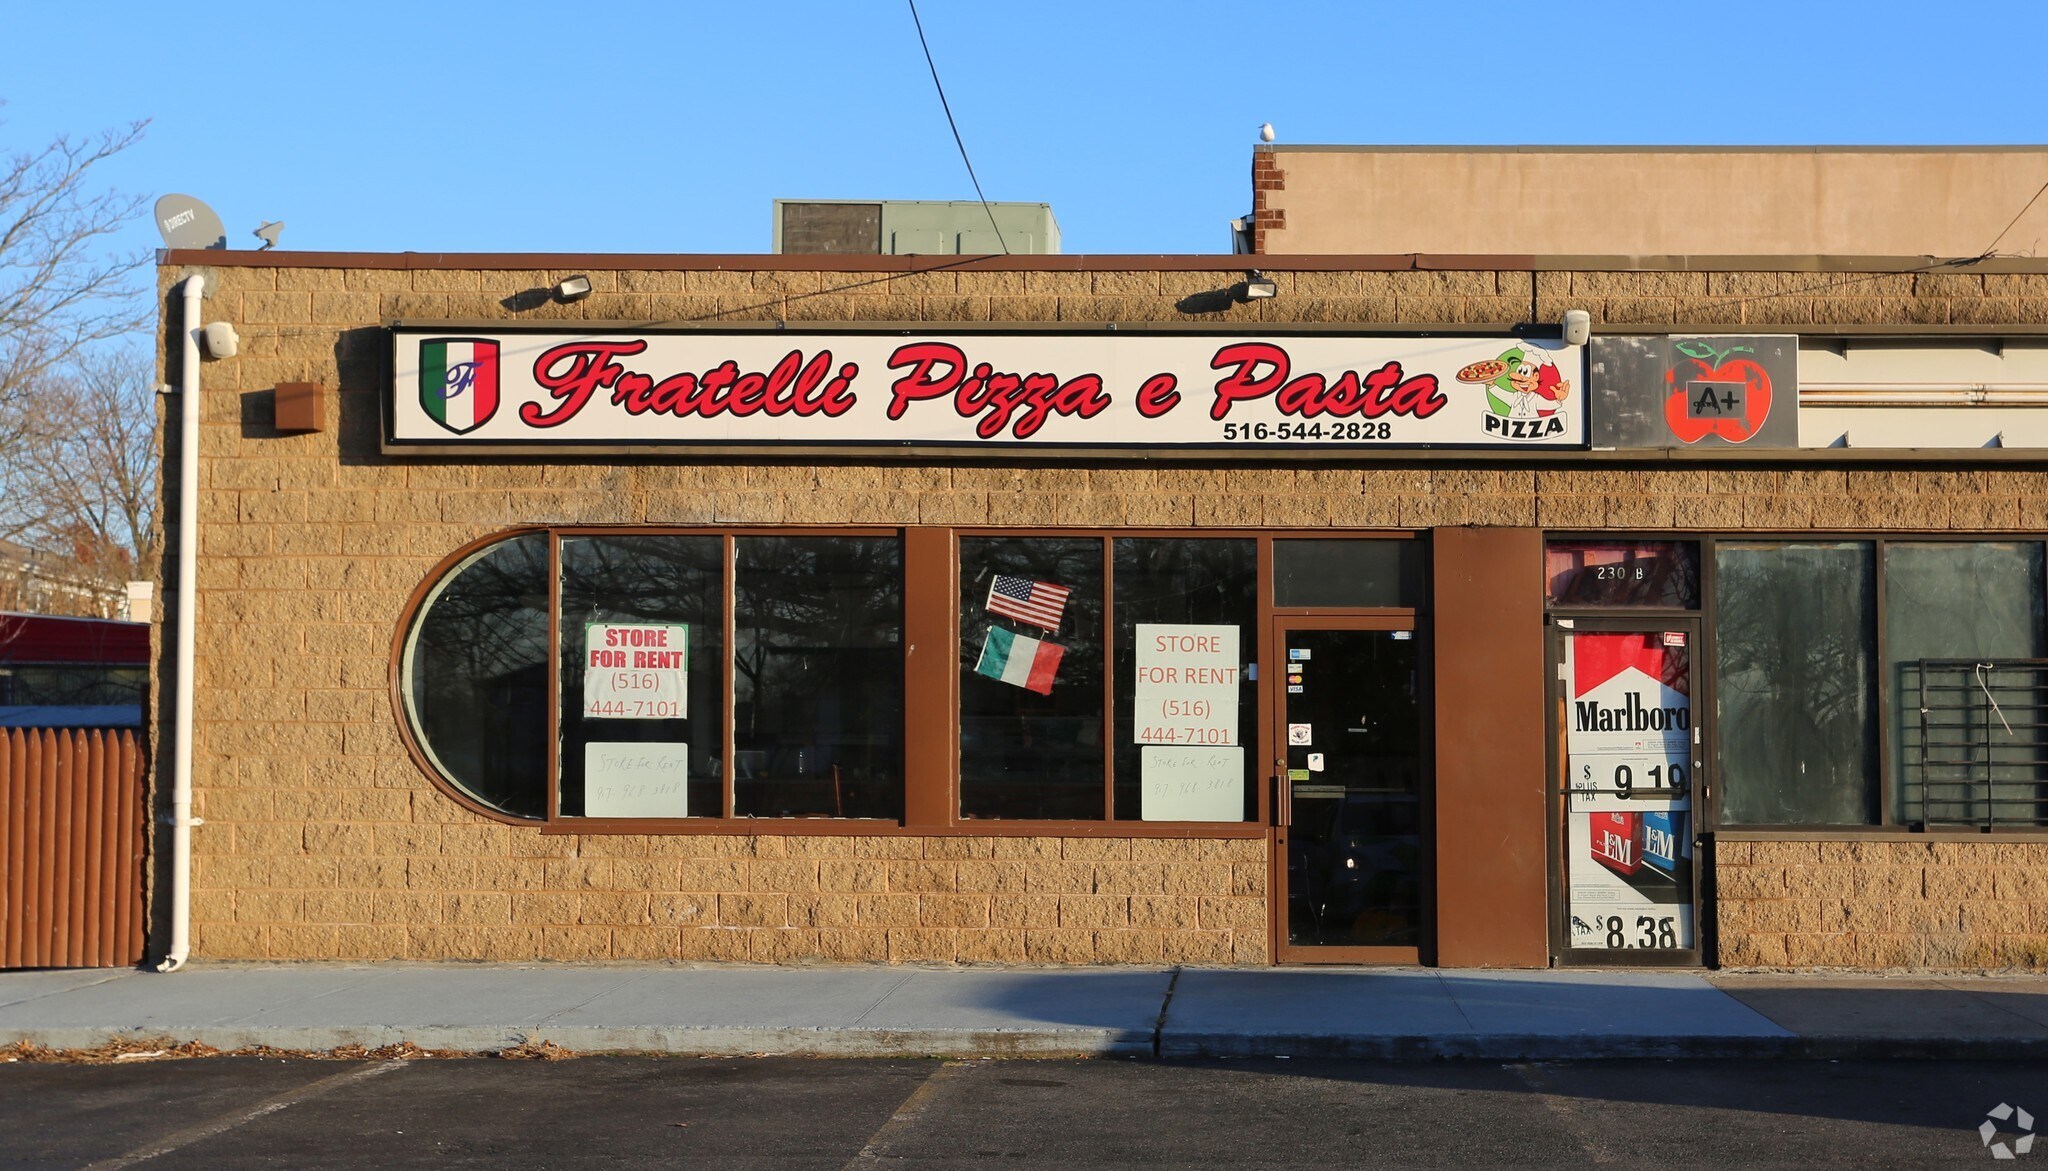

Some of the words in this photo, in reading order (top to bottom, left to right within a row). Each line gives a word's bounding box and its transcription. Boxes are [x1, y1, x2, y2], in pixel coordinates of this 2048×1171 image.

[519, 339, 859, 429] Fratelli
[887, 341, 1112, 439] Pizza
[1135, 372, 1181, 418] e
[1210, 342, 1448, 420] Pasta
[1694, 386, 1740, 415] A+
[1223, 422, 1392, 440] 516-544-2828
[1485, 416, 1564, 438] PIZZA
[1597, 566, 1626, 580] 230
[1636, 567, 1644, 580] B
[605, 629, 668, 648] STORE
[1156, 635, 1221, 653] STORE
[590, 650, 627, 668] FOR
[634, 651, 683, 669] RENT
[611, 672, 660, 692] (516)
[1139, 667, 1178, 684] FOR
[1185, 667, 1237, 685] RENT
[590, 700, 680, 717] 444-7101
[1162, 699, 1211, 720] (516)
[1575, 692, 1690, 732] Marlboro
[1141, 727, 1230, 744] 444-7101
[1603, 829, 1632, 866] L&M
[1645, 825, 1675, 861] L&M
